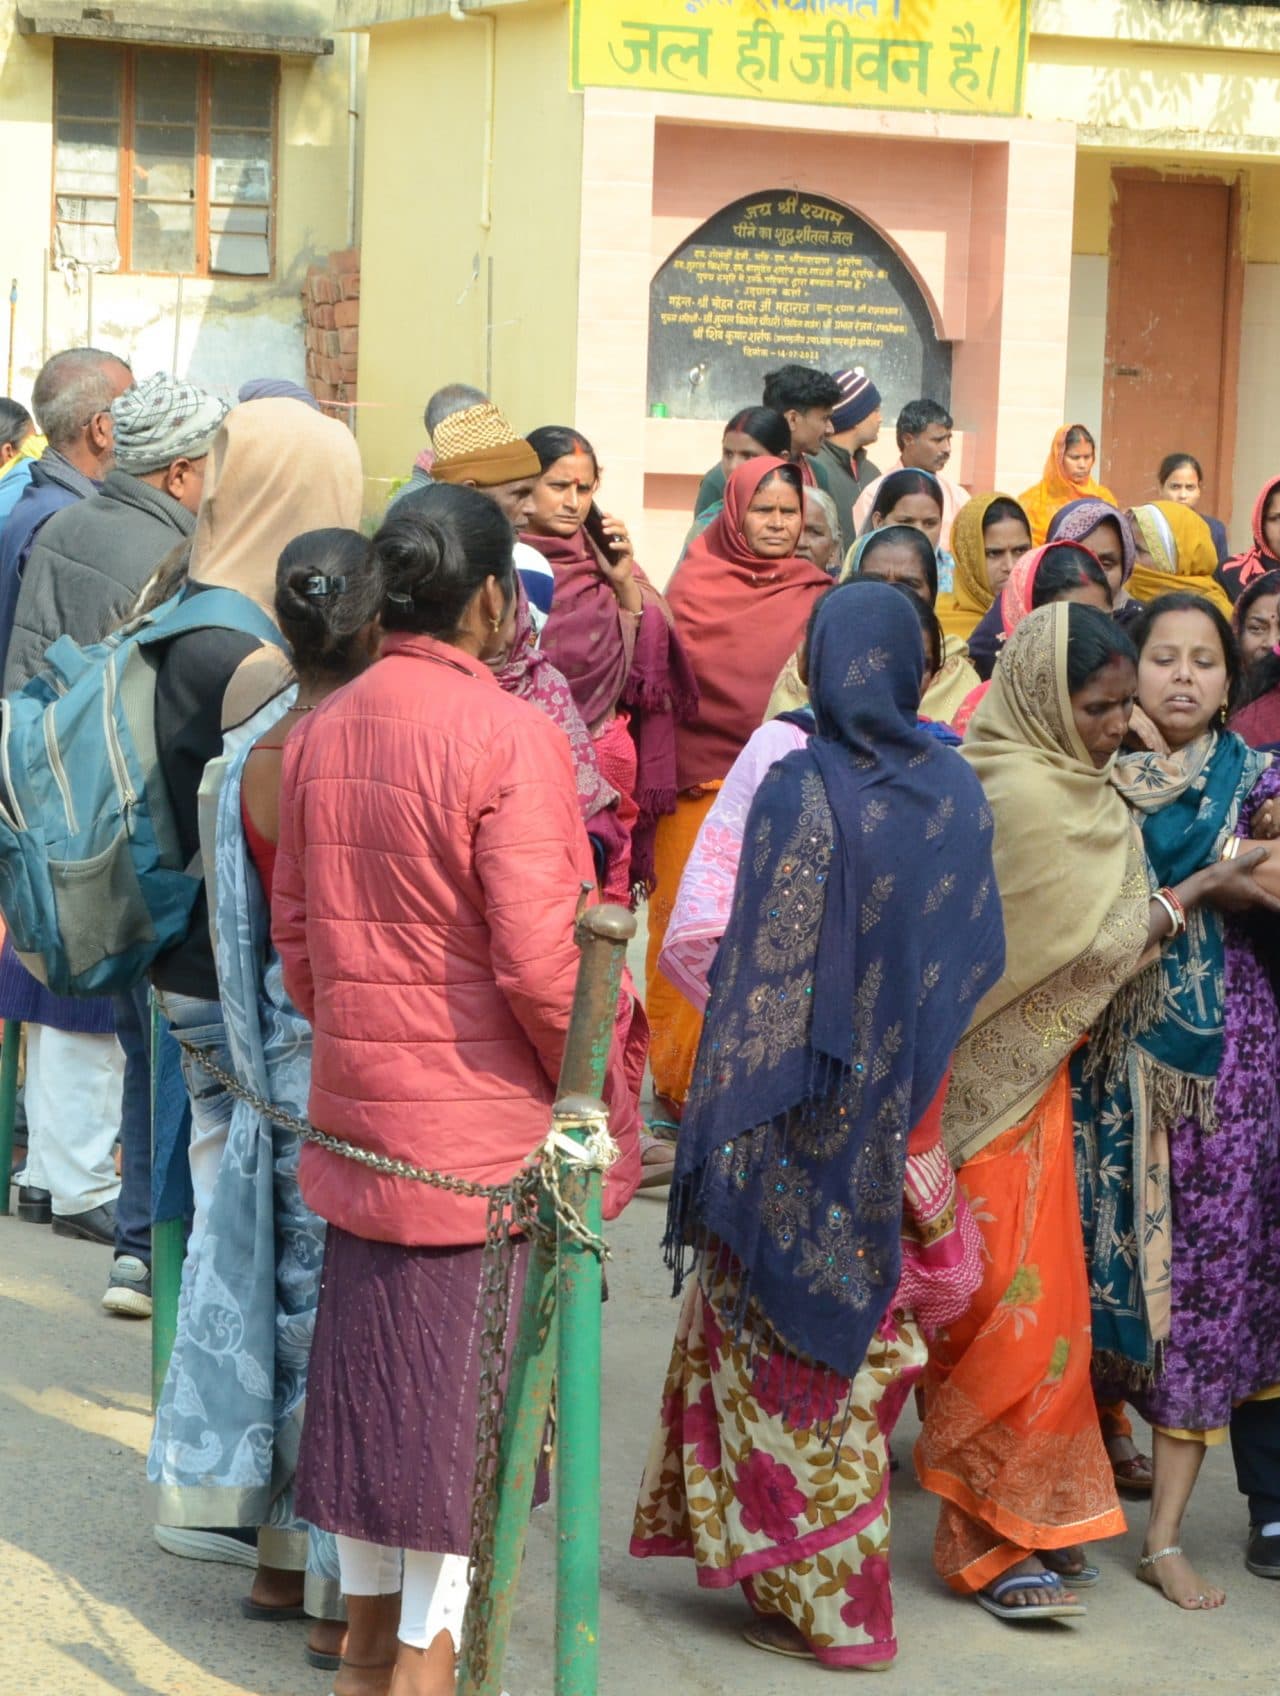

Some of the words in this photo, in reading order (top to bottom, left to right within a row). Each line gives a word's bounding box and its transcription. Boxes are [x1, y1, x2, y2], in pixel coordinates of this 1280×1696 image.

[609, 20, 712, 79] जल
[736, 16, 785, 94] ही
[789, 18, 933, 96] जीवन
[949, 21, 1002, 104] है।
[744, 202, 772, 219] जय
[777, 195, 797, 215] श्री
[800, 202, 845, 226] श्याम
[732, 221, 756, 239] पीने
[759, 226, 772, 240] का
[795, 224, 829, 246] शीतल
[830, 231, 854, 248] जल
